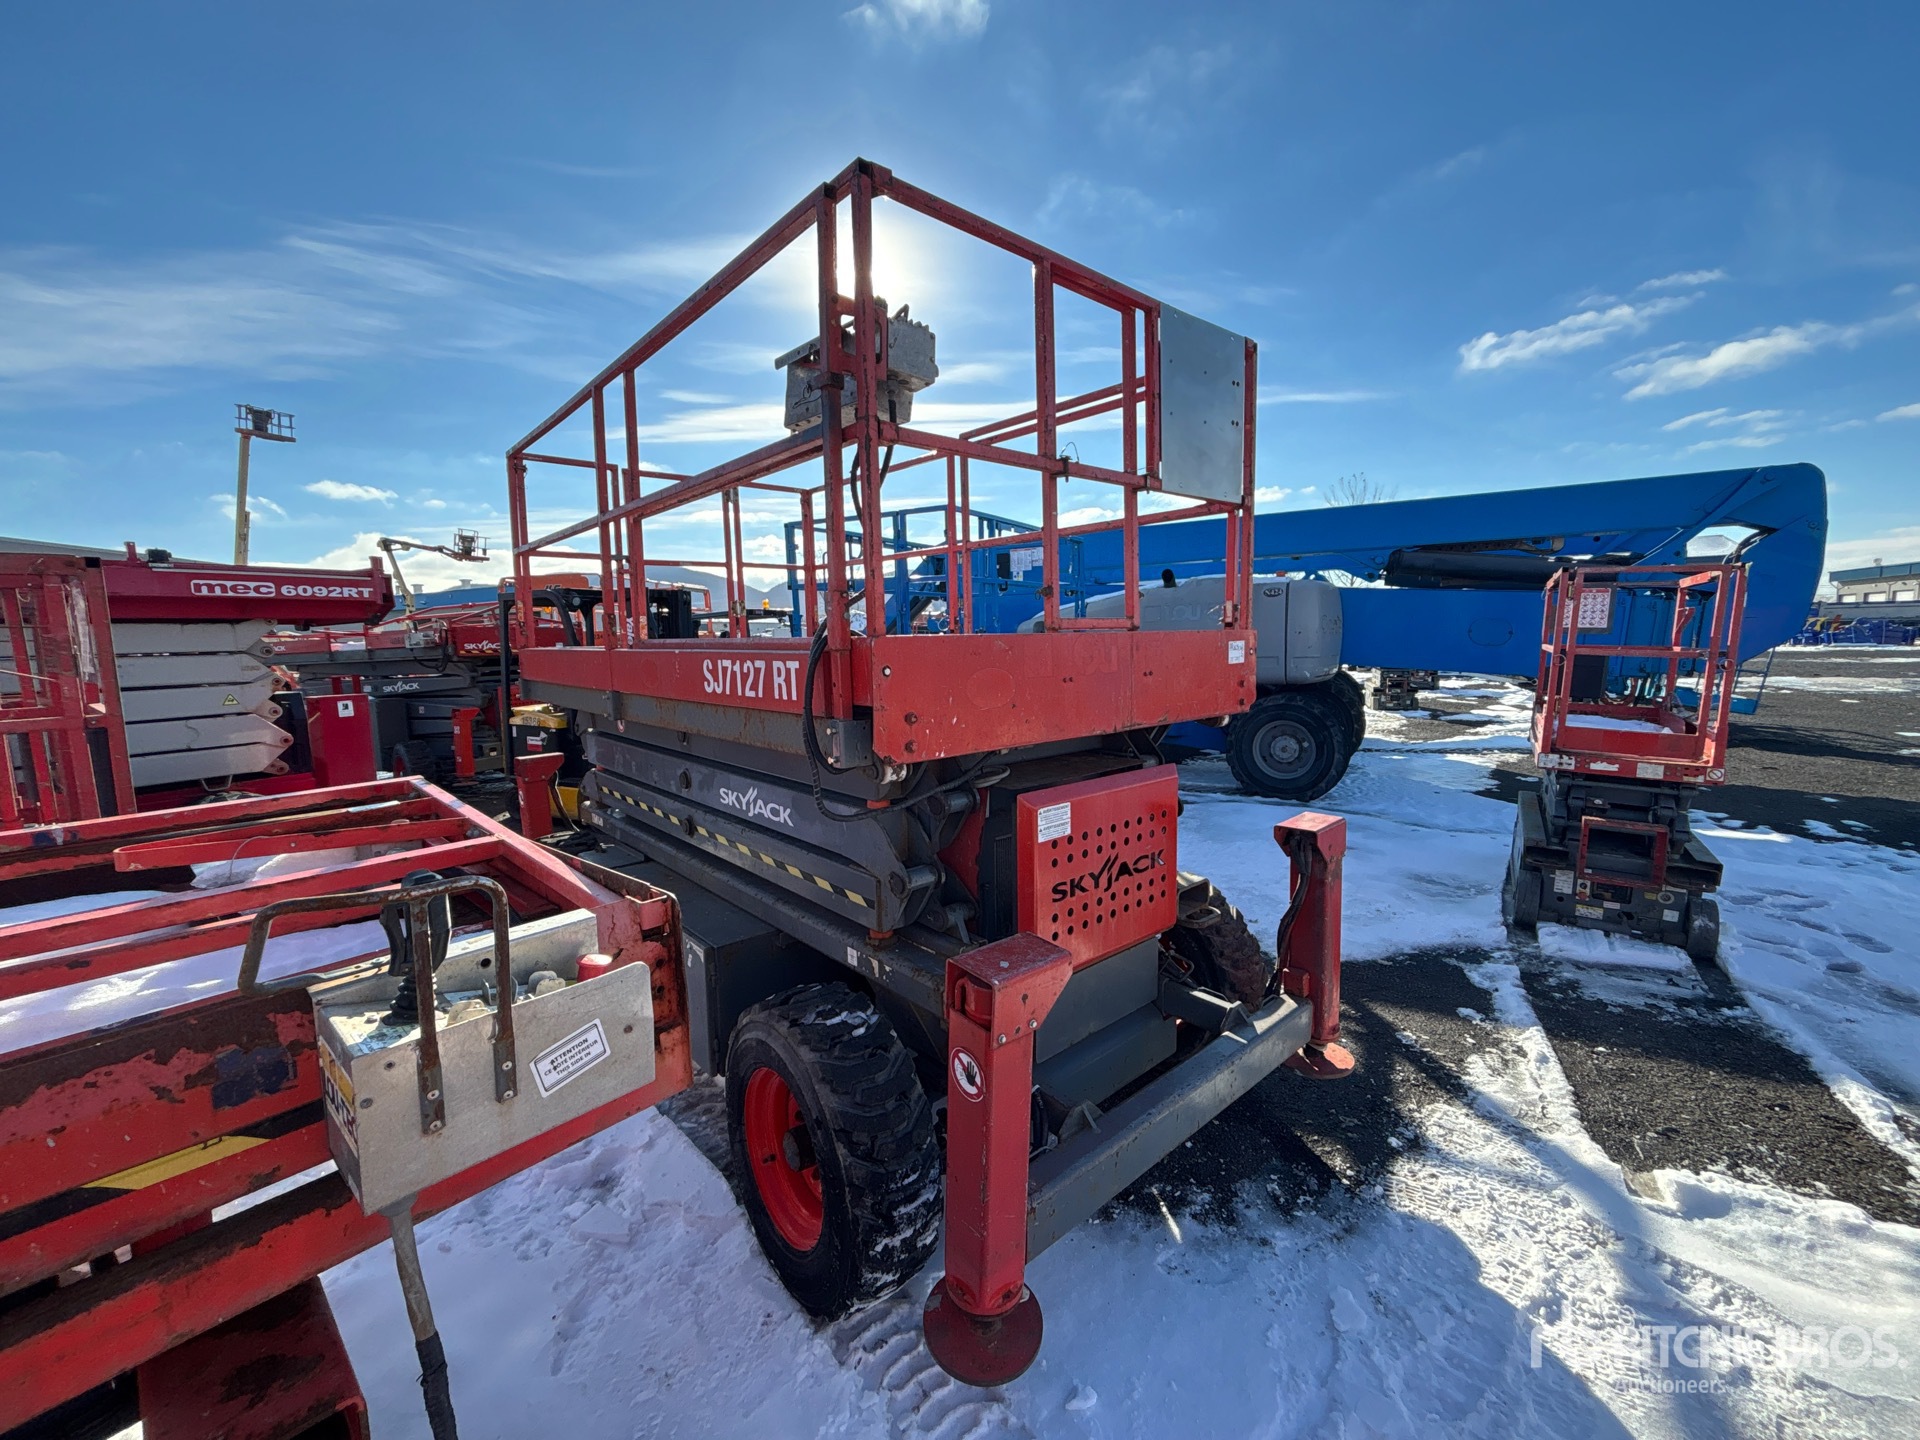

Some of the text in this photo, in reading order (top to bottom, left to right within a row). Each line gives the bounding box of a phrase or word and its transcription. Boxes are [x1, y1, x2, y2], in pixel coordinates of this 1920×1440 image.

[281, 585, 373, 598] 6092RT
[464, 640, 512, 650] SKYJAC
[383, 681, 419, 692] SKYJACK
[703, 659, 799, 700] SJ7127 RT
[720, 786, 794, 827] SKYJACK
[1052, 849, 1165, 902] SKYJACK
[550, 1038, 588, 1065] ATTENTION
[556, 1051, 591, 1075] THIS SIDE IN
[544, 1068, 552, 1076] CE
